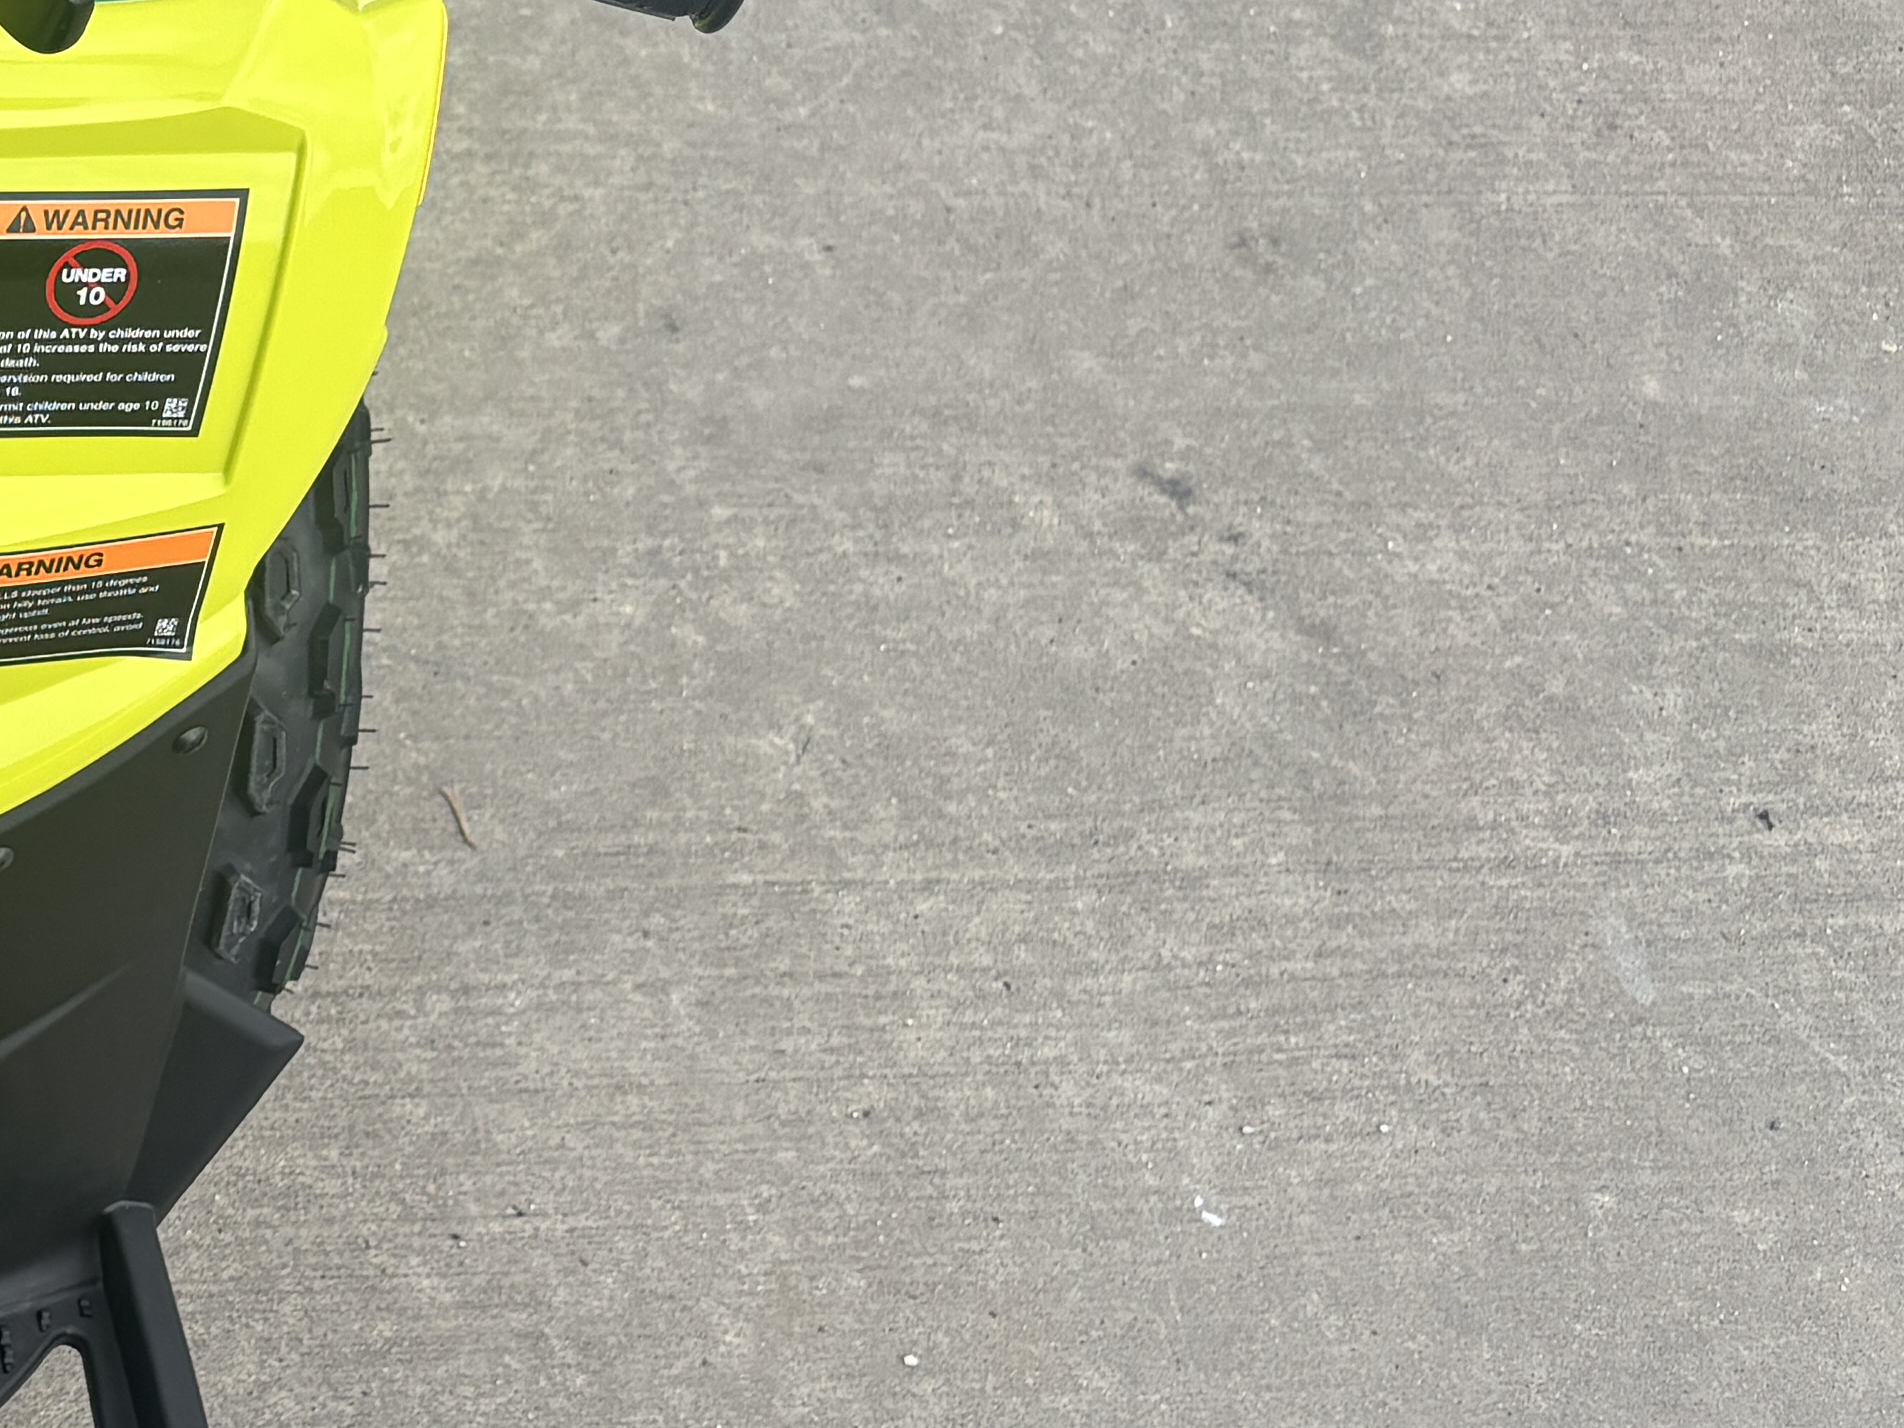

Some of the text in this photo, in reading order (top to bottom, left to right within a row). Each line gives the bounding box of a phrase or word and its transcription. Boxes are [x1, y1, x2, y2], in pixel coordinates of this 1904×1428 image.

[43, 207, 185, 231] WARNING
[61, 267, 127, 284] UNDER
[76, 287, 106, 306] 10
[16, 328, 32, 340] of
[33, 328, 57, 339] this
[58, 327, 88, 339] ATV
[88, 327, 106, 341] by
[107, 327, 161, 339] children
[162, 326, 202, 338] under
